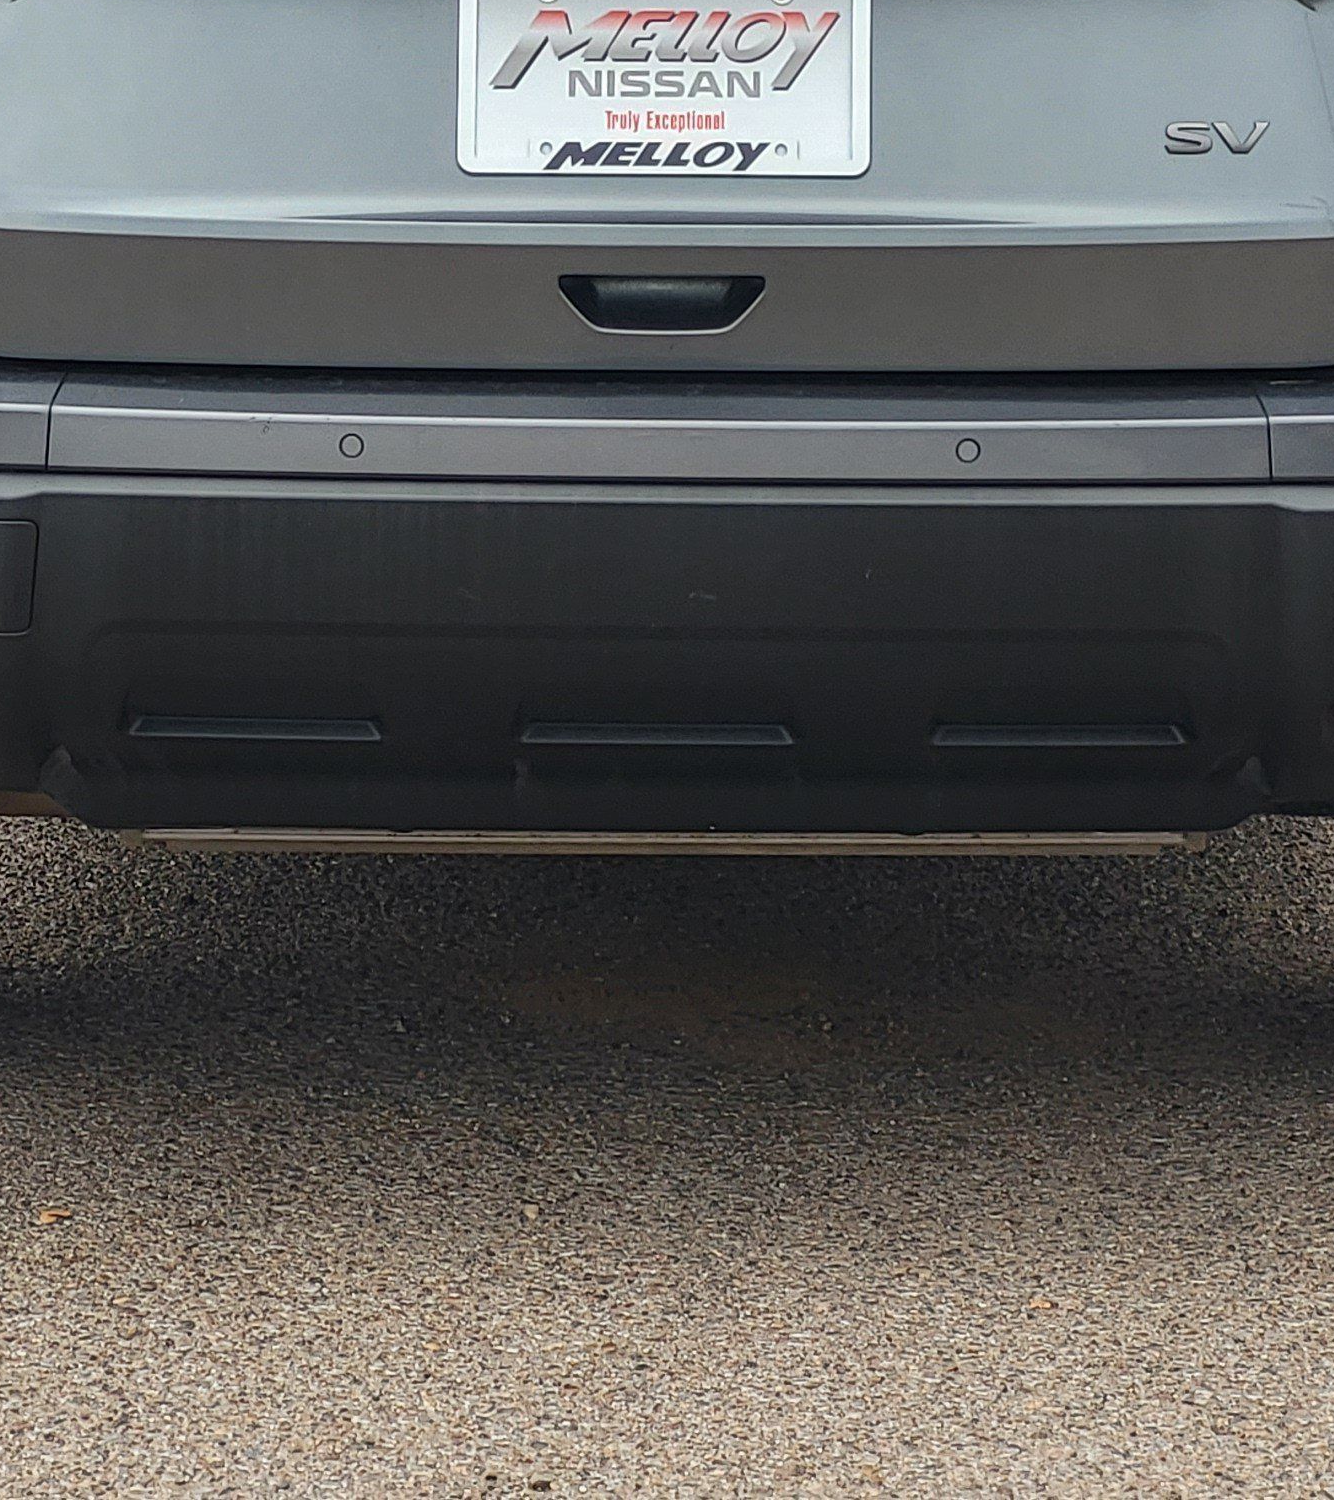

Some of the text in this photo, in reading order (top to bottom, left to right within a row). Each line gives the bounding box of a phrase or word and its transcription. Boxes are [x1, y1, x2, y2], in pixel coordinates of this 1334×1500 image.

[490, 10, 840, 91] MELLOY
[568, 70, 761, 98] NISSAN
[606, 110, 725, 133] Truly Exceptional
[1163, 120, 1271, 156] SV
[543, 142, 772, 171] MELLOY
